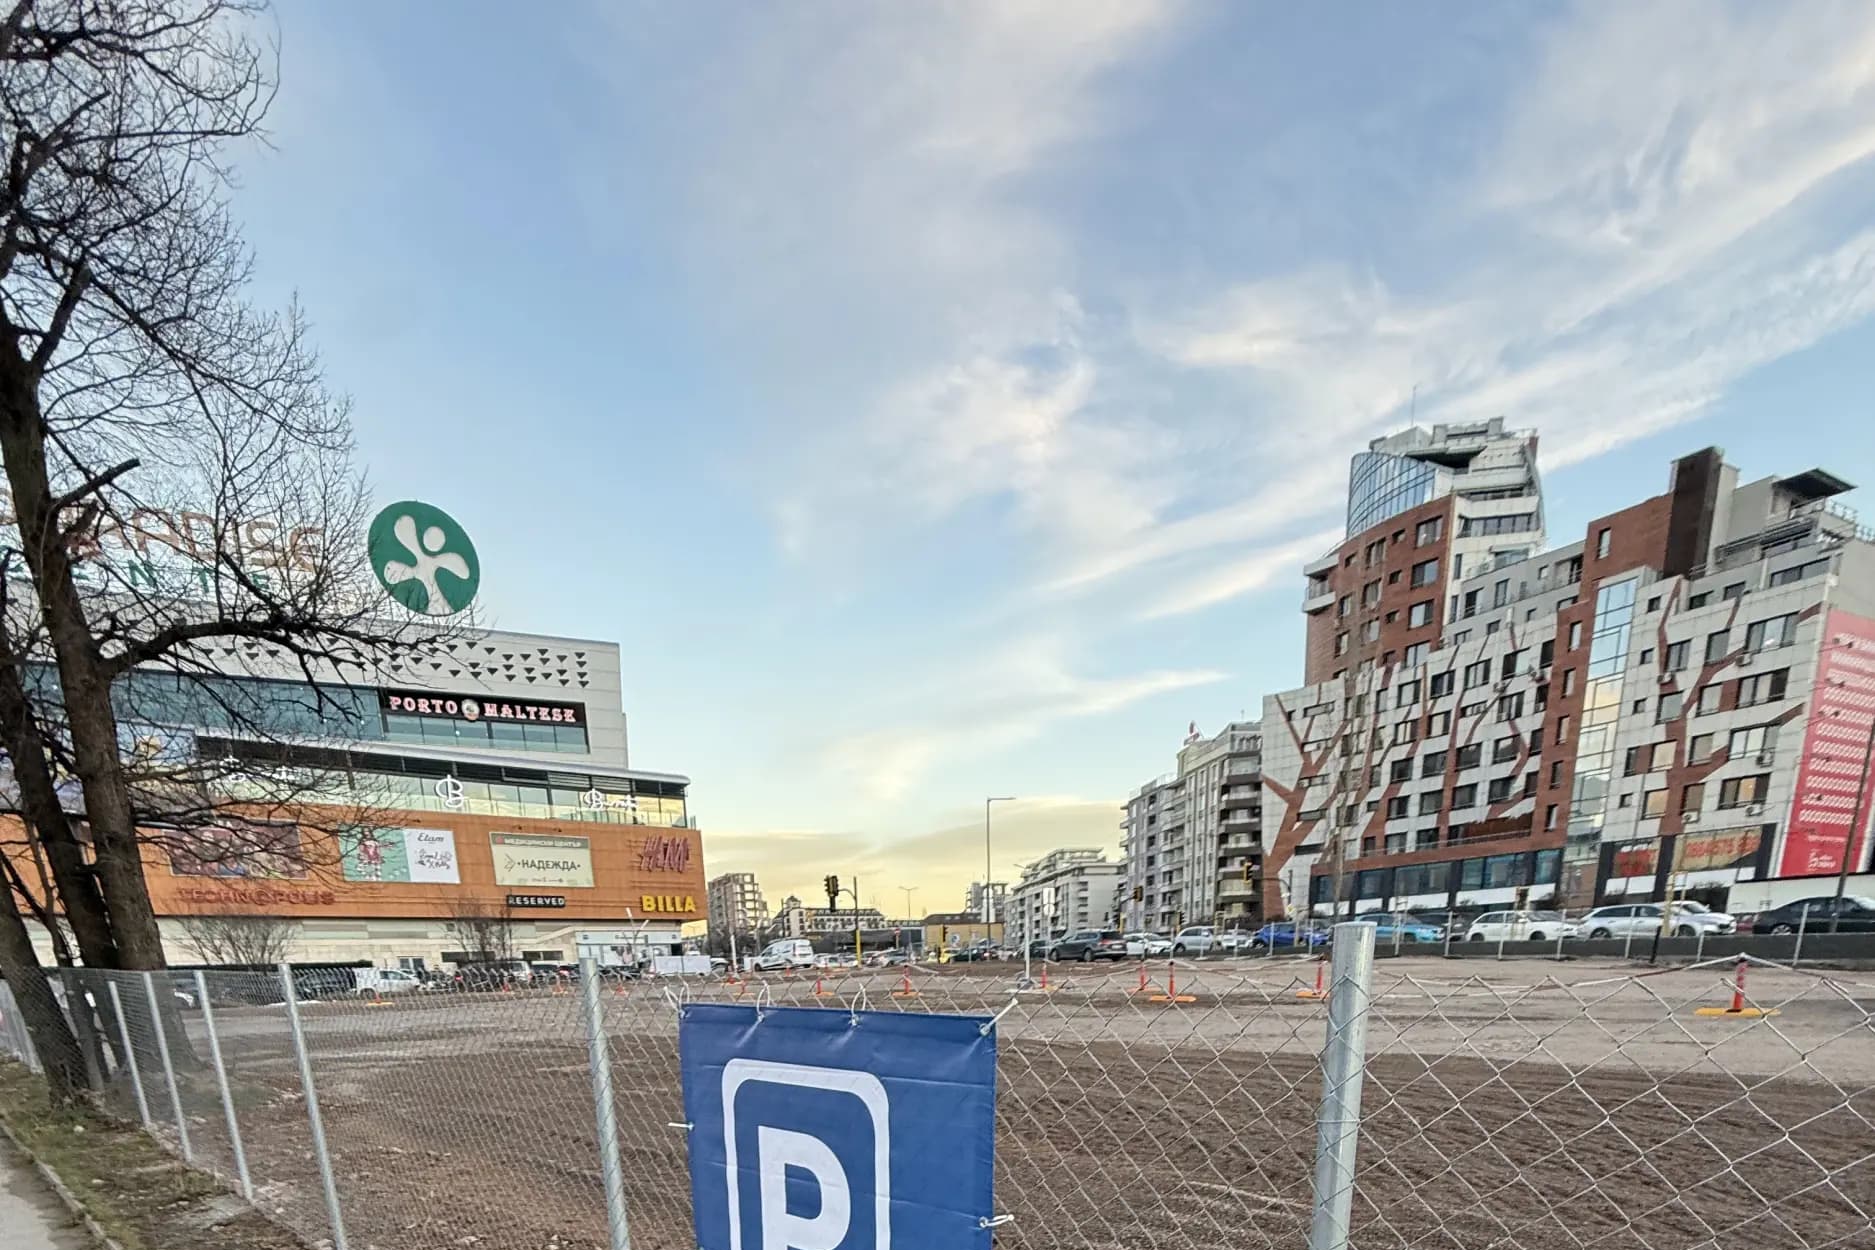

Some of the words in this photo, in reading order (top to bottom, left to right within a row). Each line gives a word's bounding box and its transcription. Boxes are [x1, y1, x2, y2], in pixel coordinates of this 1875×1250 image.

[389, 696, 458, 714] PORTO
[484, 702, 576, 722] MALTESE
[521, 859, 577, 871] НАДЕЖДА
[508, 896, 565, 905] RESERVED
[642, 895, 696, 912] BILLA
